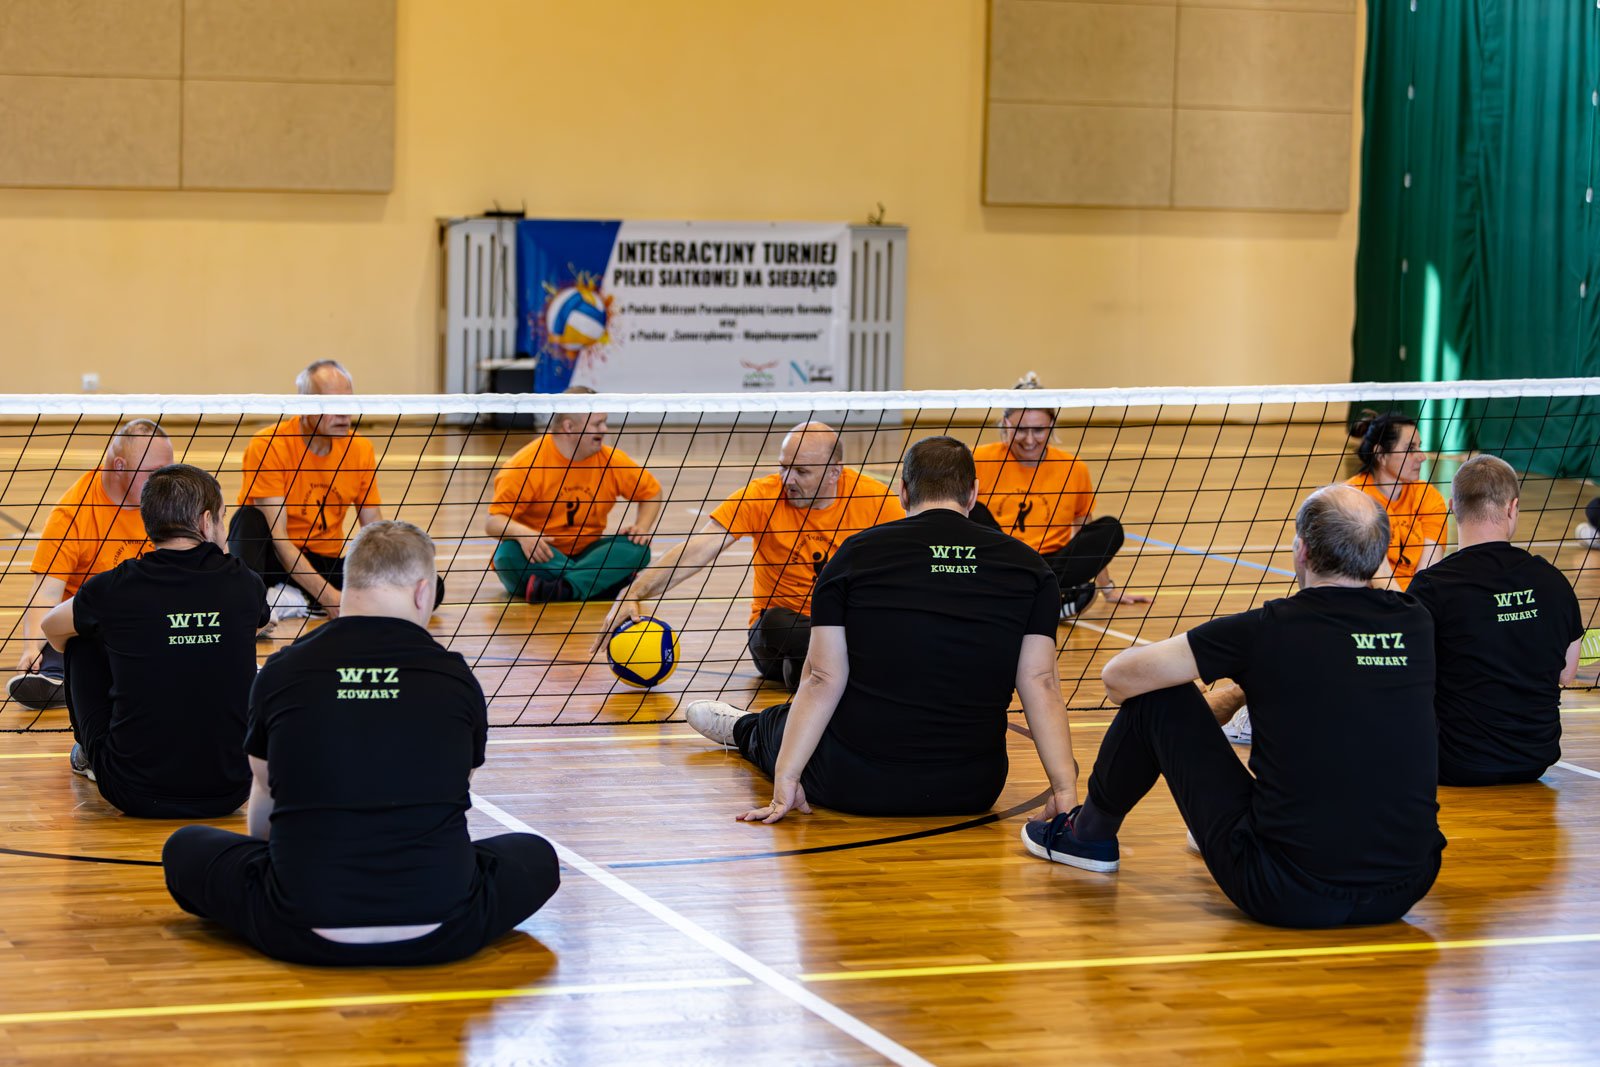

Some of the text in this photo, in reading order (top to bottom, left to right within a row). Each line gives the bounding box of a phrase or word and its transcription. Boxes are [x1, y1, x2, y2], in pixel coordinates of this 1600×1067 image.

[618, 241, 838, 265] INTEGRACYJNY TURNIEJ
[613, 268, 838, 292] PIŁKI SIATKOWEJ NA SIEDZĄCO
[929, 544, 977, 561] WTZ
[930, 564, 978, 575] KOWARY
[1494, 589, 1536, 608] WTZ
[167, 612, 221, 629] WTZ
[1497, 609, 1538, 623] KOWARY
[168, 634, 222, 646] KOWARY
[1351, 632, 1405, 650] WTZ
[1356, 655, 1408, 667] KOWARY
[337, 667, 399, 684] WTZ
[337, 688, 400, 700] KOWARY
